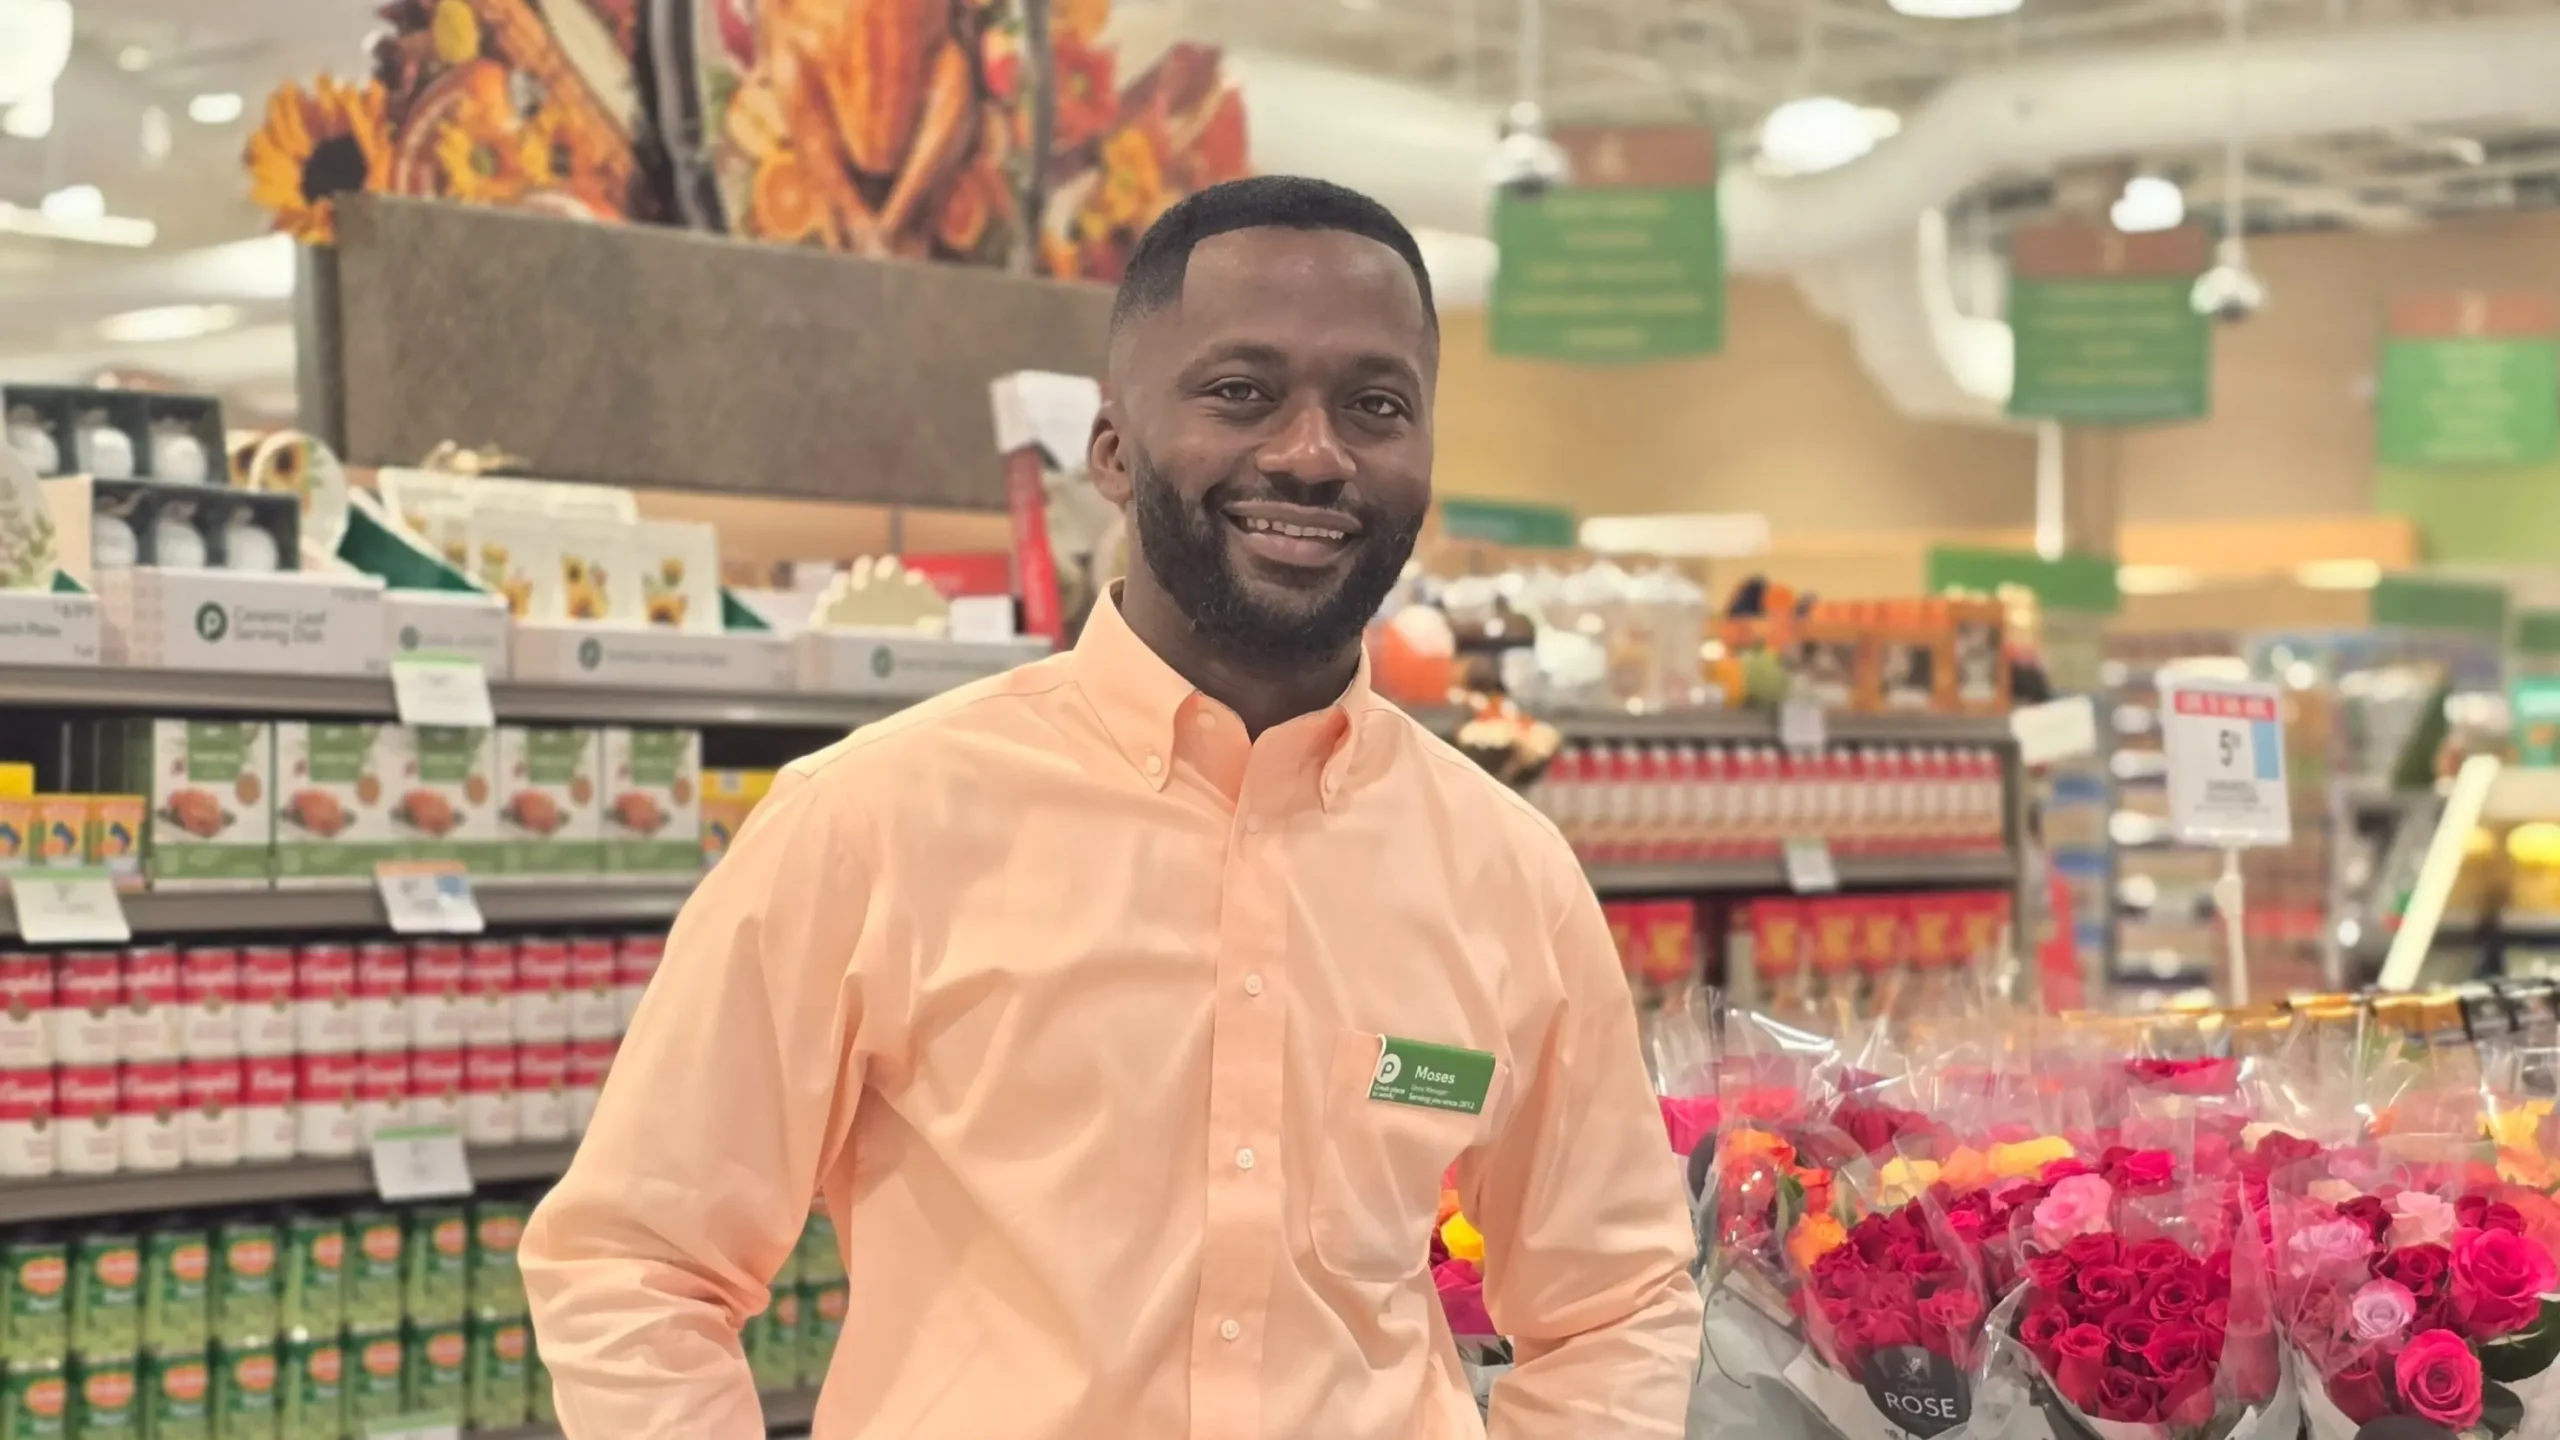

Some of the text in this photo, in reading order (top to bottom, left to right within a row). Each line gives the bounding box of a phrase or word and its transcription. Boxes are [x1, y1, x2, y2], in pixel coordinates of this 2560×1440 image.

[1414, 1064, 1456, 1085] Moses
[1408, 1092, 1431, 1104] Serving
[1442, 1099, 1458, 1107] since
[1884, 1391, 1957, 1419] ROSE
